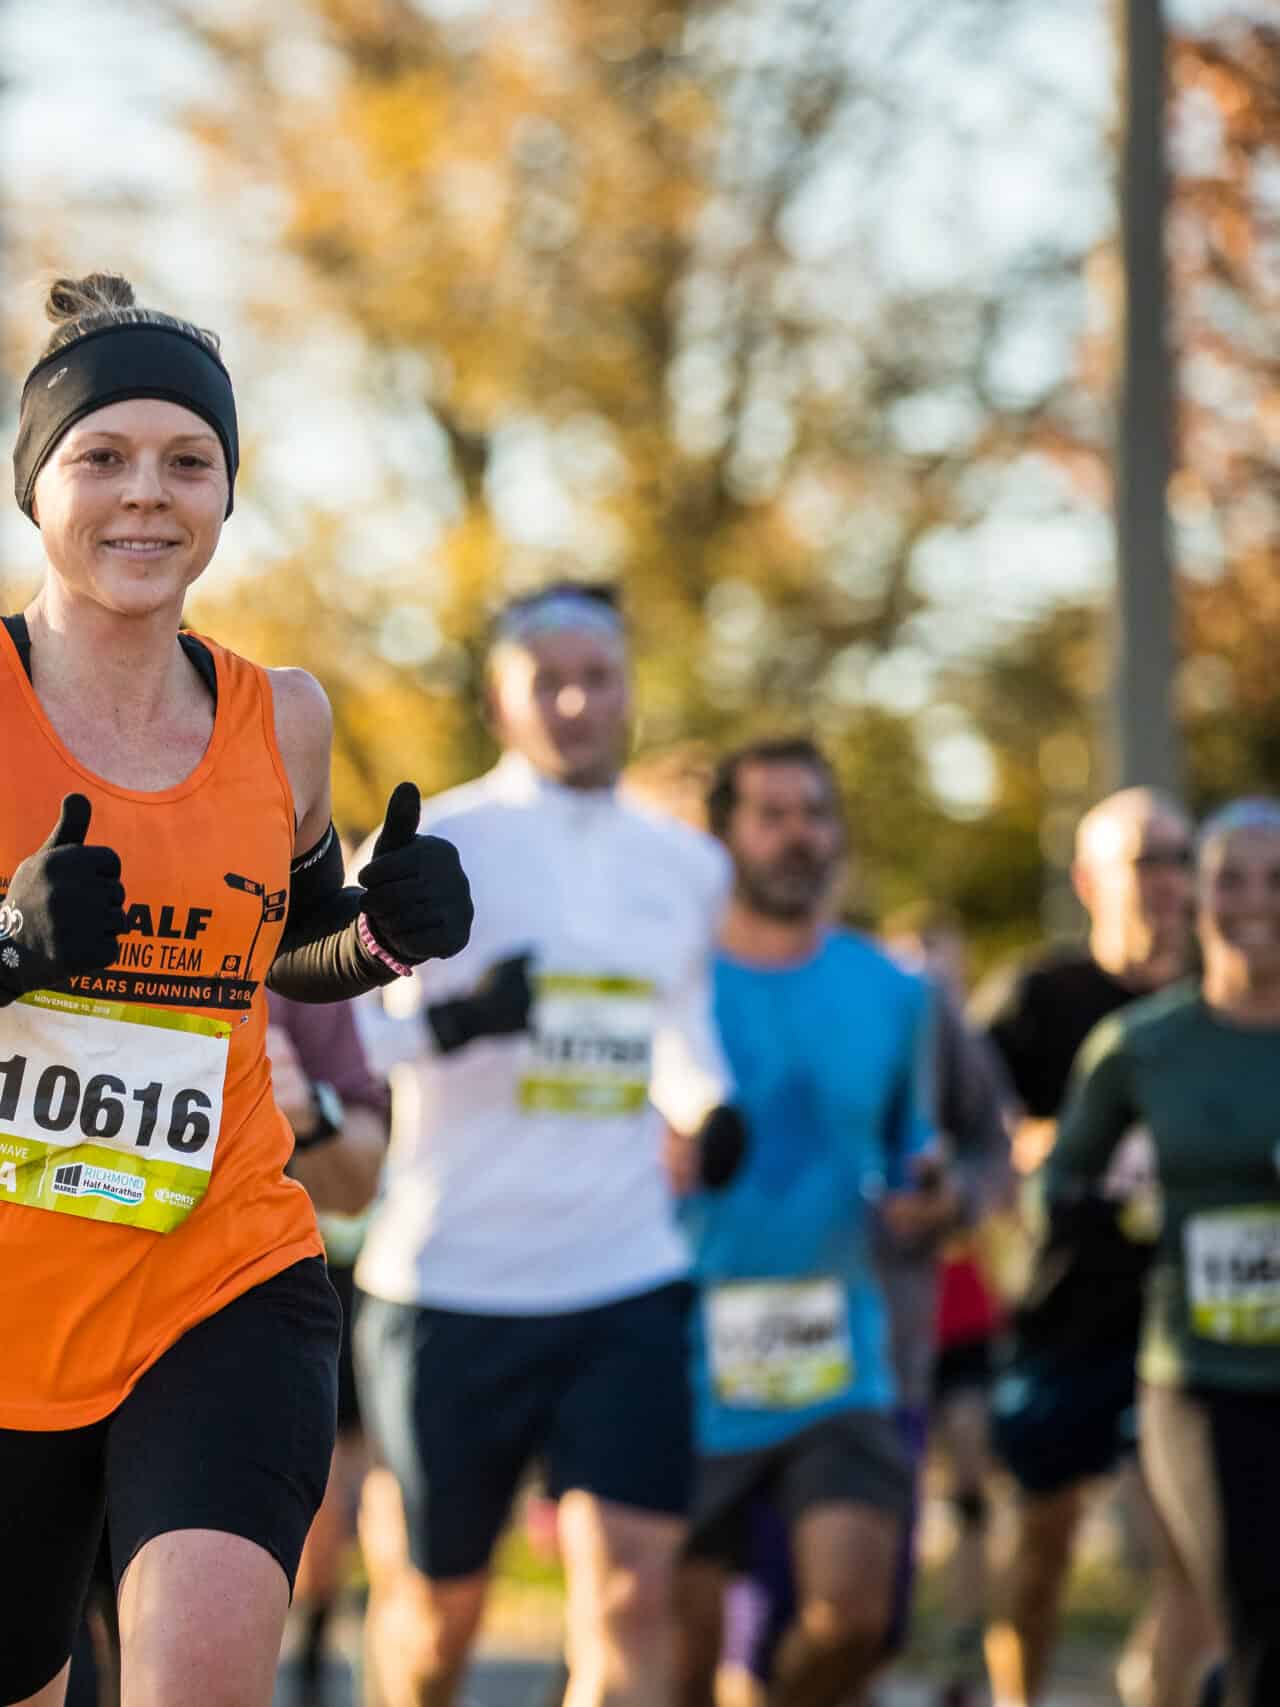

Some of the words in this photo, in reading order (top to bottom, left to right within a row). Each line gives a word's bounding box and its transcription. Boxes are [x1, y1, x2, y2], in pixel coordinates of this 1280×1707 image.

[118, 903, 213, 940] ALF
[160, 944, 203, 972] TEAM
[69, 975, 128, 993] YEARS
[134, 981, 212, 1000] RUNNING
[83, 1179, 101, 1189] Half
[103, 1184, 142, 1199] Marathon
[85, 1167, 145, 1189] RICHMOND
